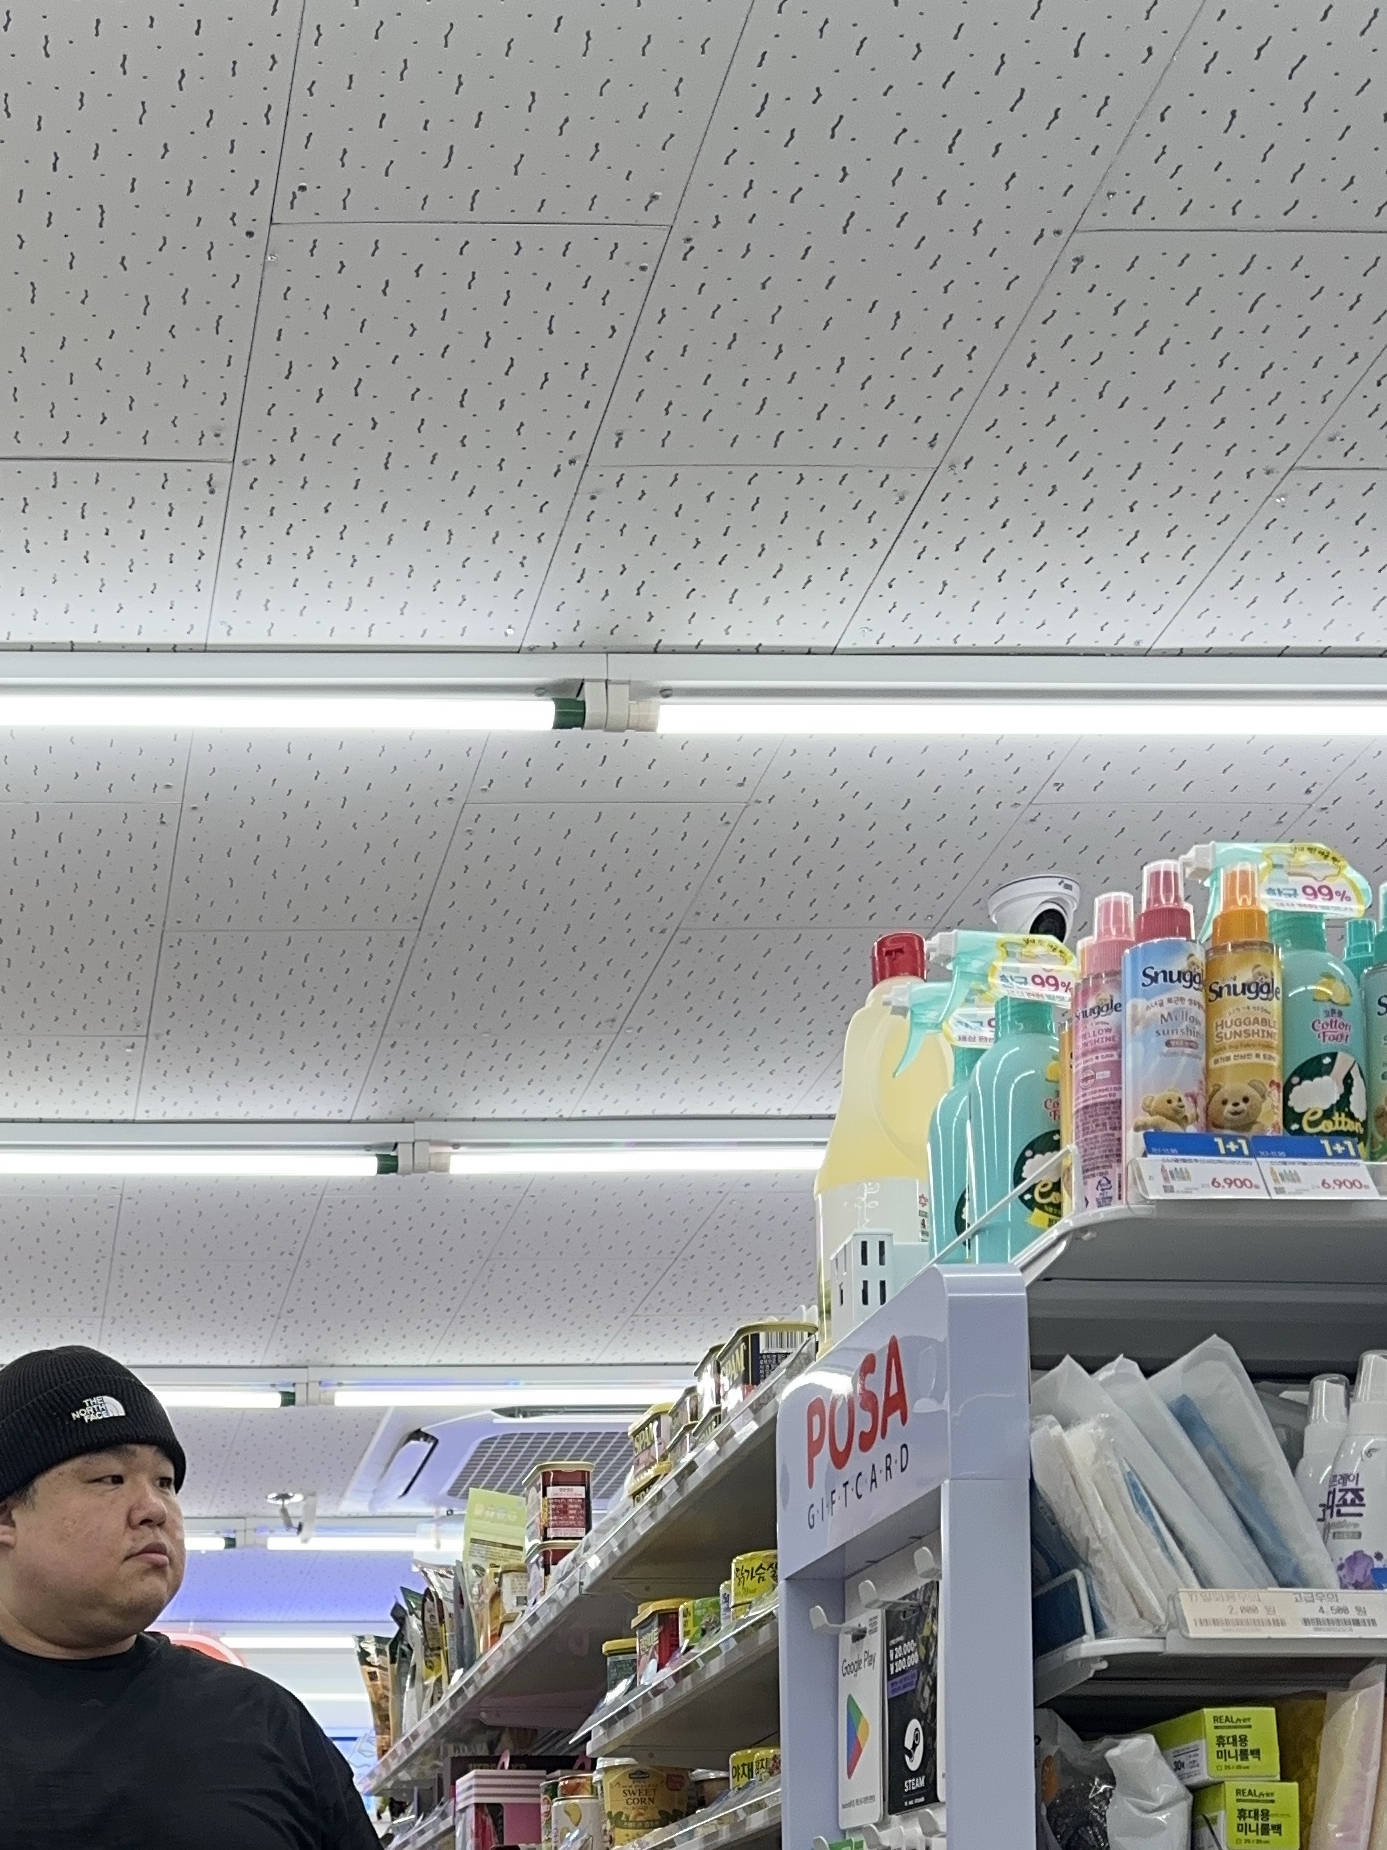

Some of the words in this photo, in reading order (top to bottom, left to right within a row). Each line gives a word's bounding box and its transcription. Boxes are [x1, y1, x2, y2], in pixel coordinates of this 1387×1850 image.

[1302, 884, 1353, 903] 99%
[1030, 973, 1074, 994] 99%
[1208, 978, 1281, 1004] Snuggle
[1311, 1017, 1352, 1033] Cotton
[1302, 1107, 1365, 1135] Cotton
[1214, 1137, 1250, 1156] 1+1
[1320, 1138, 1356, 1158] 1+1
[1211, 1177, 1253, 1190] 6,900
[1321, 1177, 1362, 1190] 6,900
[83, 1396, 103, 1407] THE
[71, 1404, 106, 1421] NORTH
[84, 1412, 109, 1424] FACE
[806, 1334, 909, 1490] POSA
[841, 1653, 863, 1679] Google
[863, 1651, 877, 1671] Play
[1213, 1716, 1235, 1725] REAL
[1215, 1734, 1249, 1748] 휴대용
[622, 1787, 658, 1798] SWEET
[904, 1775, 926, 1794] STEAM
[625, 1796, 655, 1806] CORN
[1235, 1788, 1258, 1798] REAL
[1236, 1808, 1271, 1821] 휴대용
